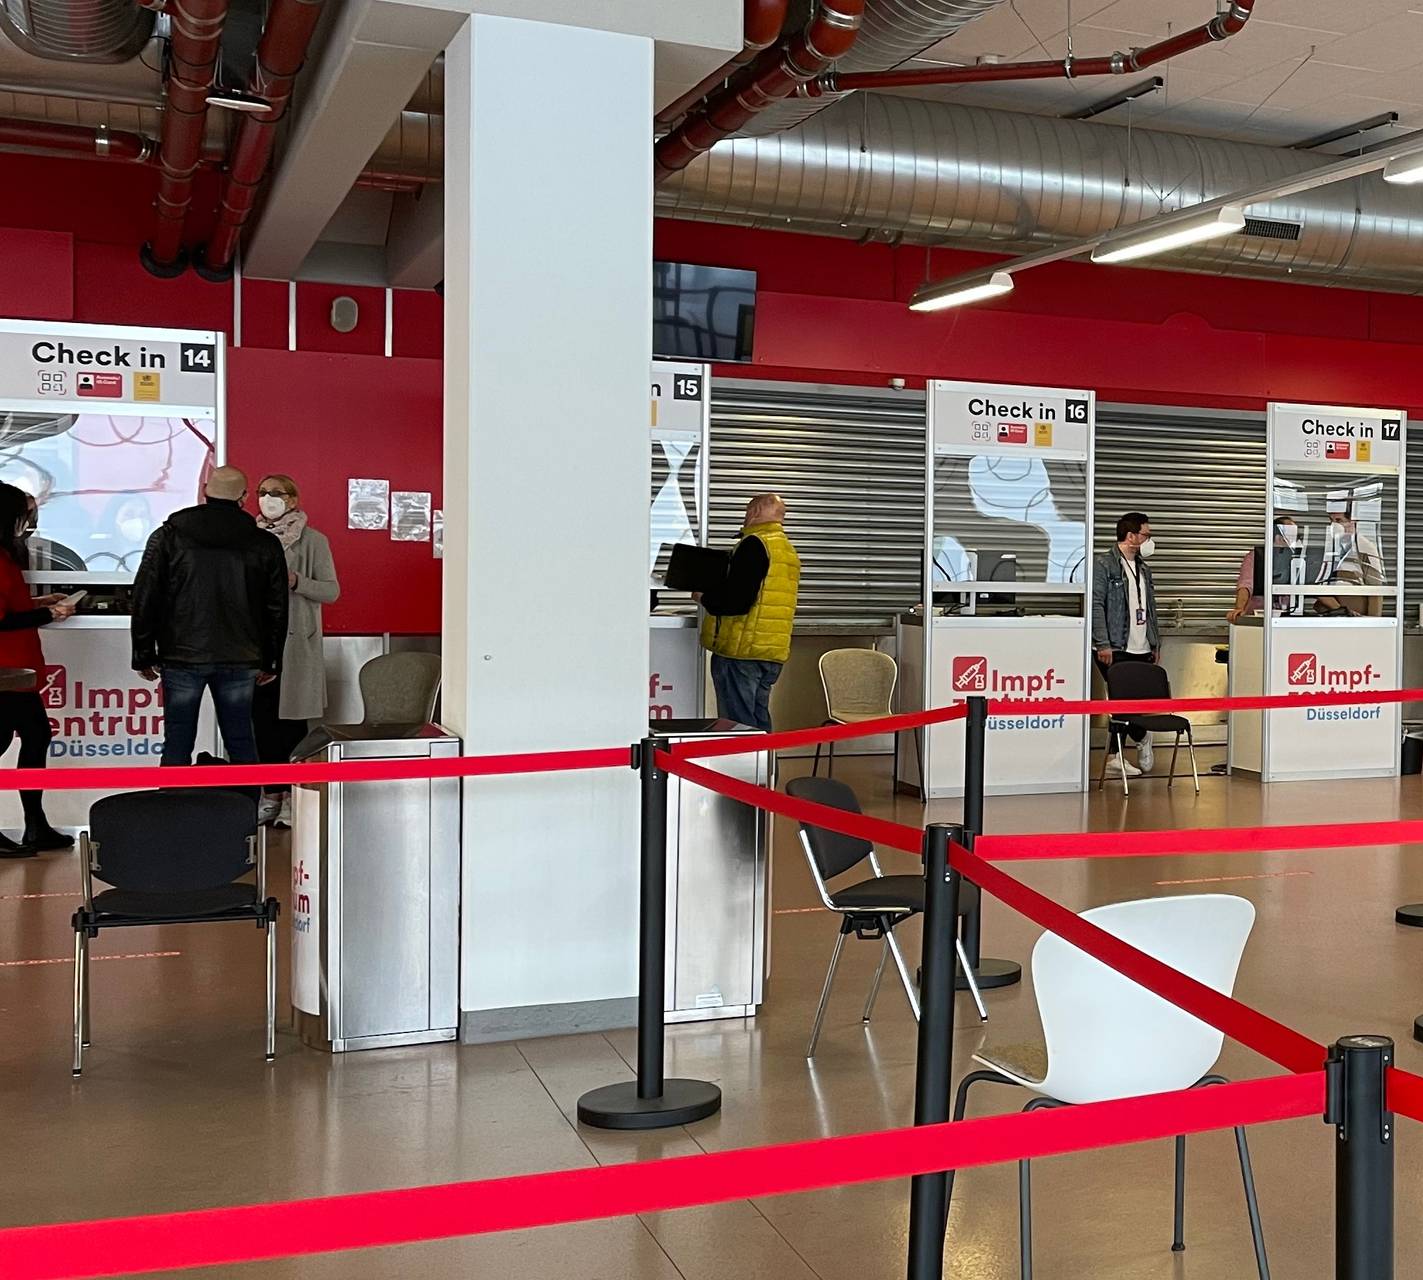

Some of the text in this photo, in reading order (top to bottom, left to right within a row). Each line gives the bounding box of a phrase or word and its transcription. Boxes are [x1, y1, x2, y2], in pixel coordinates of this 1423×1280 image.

[31, 341, 212, 369] Check in 14
[676, 379, 699, 396] 15
[968, 398, 1085, 420] Check in 16
[1301, 419, 1398, 438] Check in 17
[992, 669, 1065, 696] Impf-
[1320, 664, 1381, 690] Impf-
[987, 714, 1065, 730] üsseldorf
[1306, 706, 1381, 721] Düsseldorf
[50, 738, 165, 758] Düsseldo
